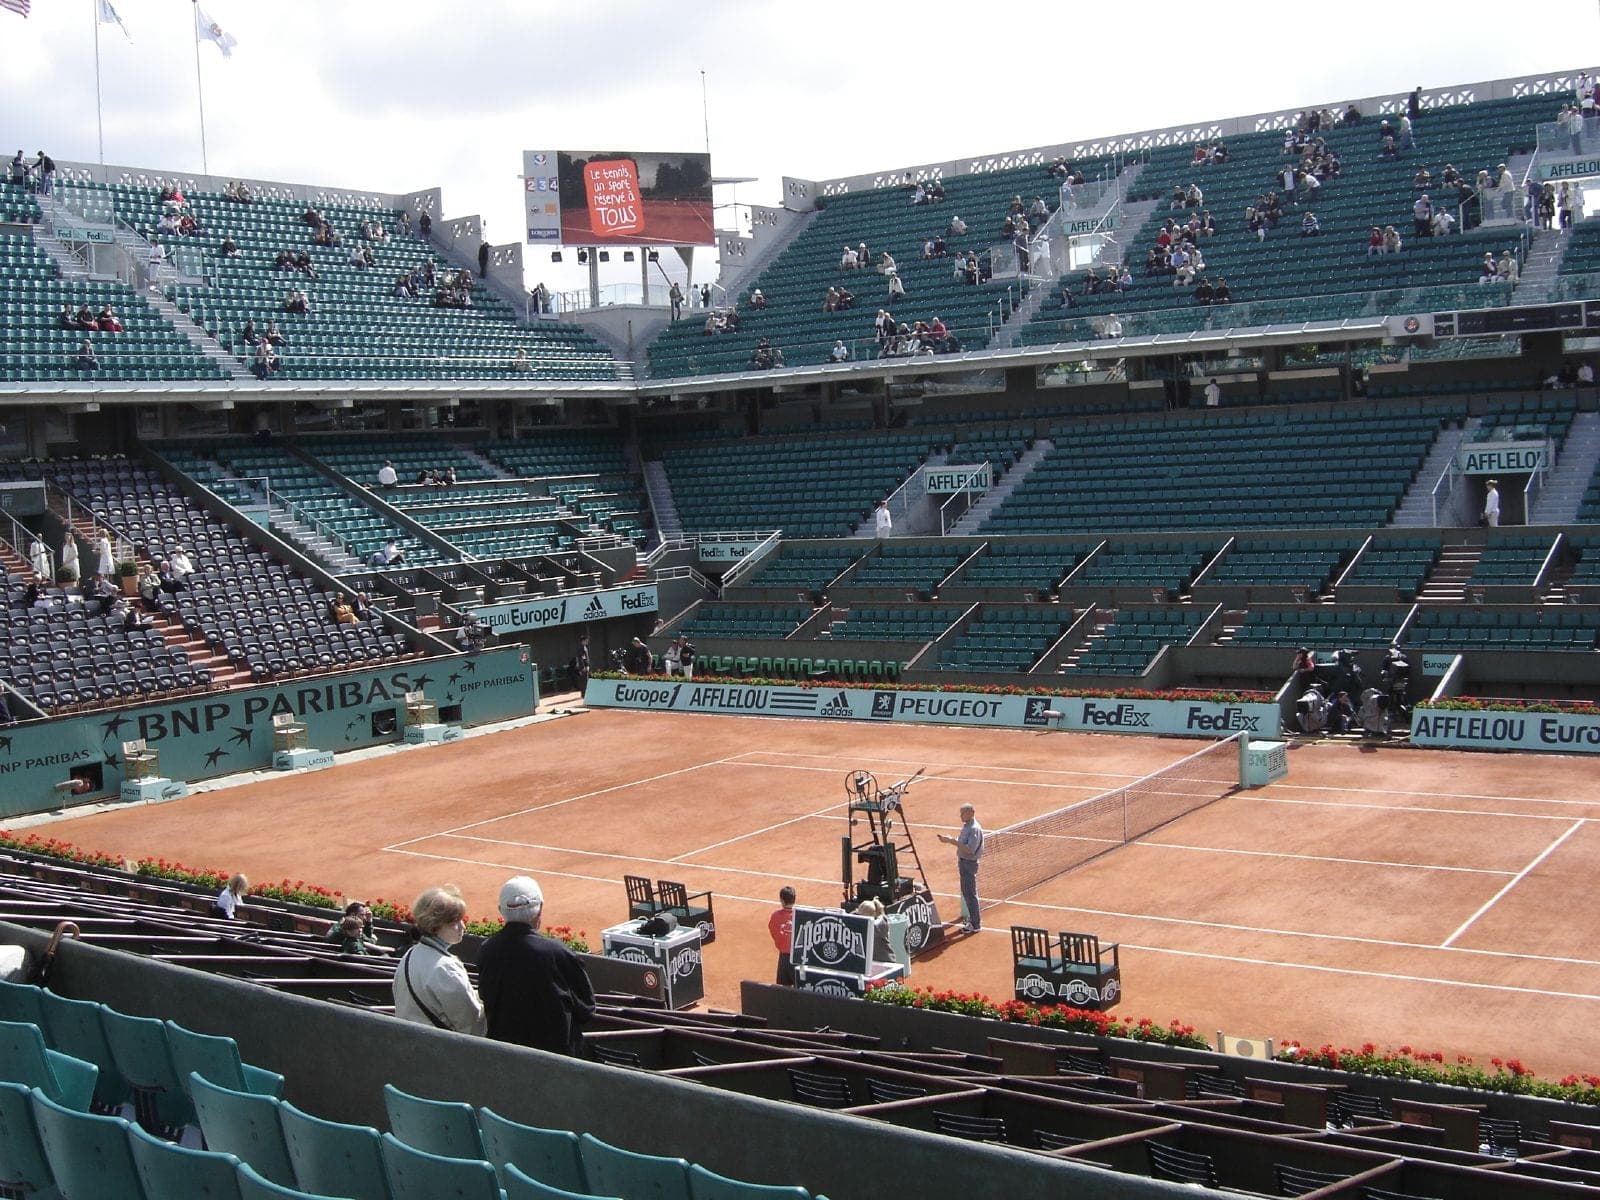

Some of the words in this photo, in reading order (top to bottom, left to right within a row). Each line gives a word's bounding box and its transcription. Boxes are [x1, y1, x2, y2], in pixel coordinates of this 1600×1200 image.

[594, 182, 605, 192] un
[608, 178, 631, 192] sport
[595, 205, 637, 226] TOUS
[1466, 451, 1549, 471] AFFLELOU
[511, 600, 567, 627] Europe1
[583, 610, 607, 620] adidas
[460, 681, 482, 693] BNP
[483, 673, 526, 689] PARIBAS
[138, 703, 231, 743] BNP
[243, 671, 410, 726] PARIBAS
[614, 684, 683, 708] Europe1
[689, 687, 769, 709] AFFLELOU
[820, 706, 854, 717] adidas
[899, 697, 1003, 718] PEUGEOT
[1082, 703, 1151, 727] FedEx
[1186, 706, 1260, 732] FedEx
[1414, 715, 1525, 742] AFFLELOU
[25, 749, 91, 770] PARIBAS
[803, 919, 860, 965] perrier
